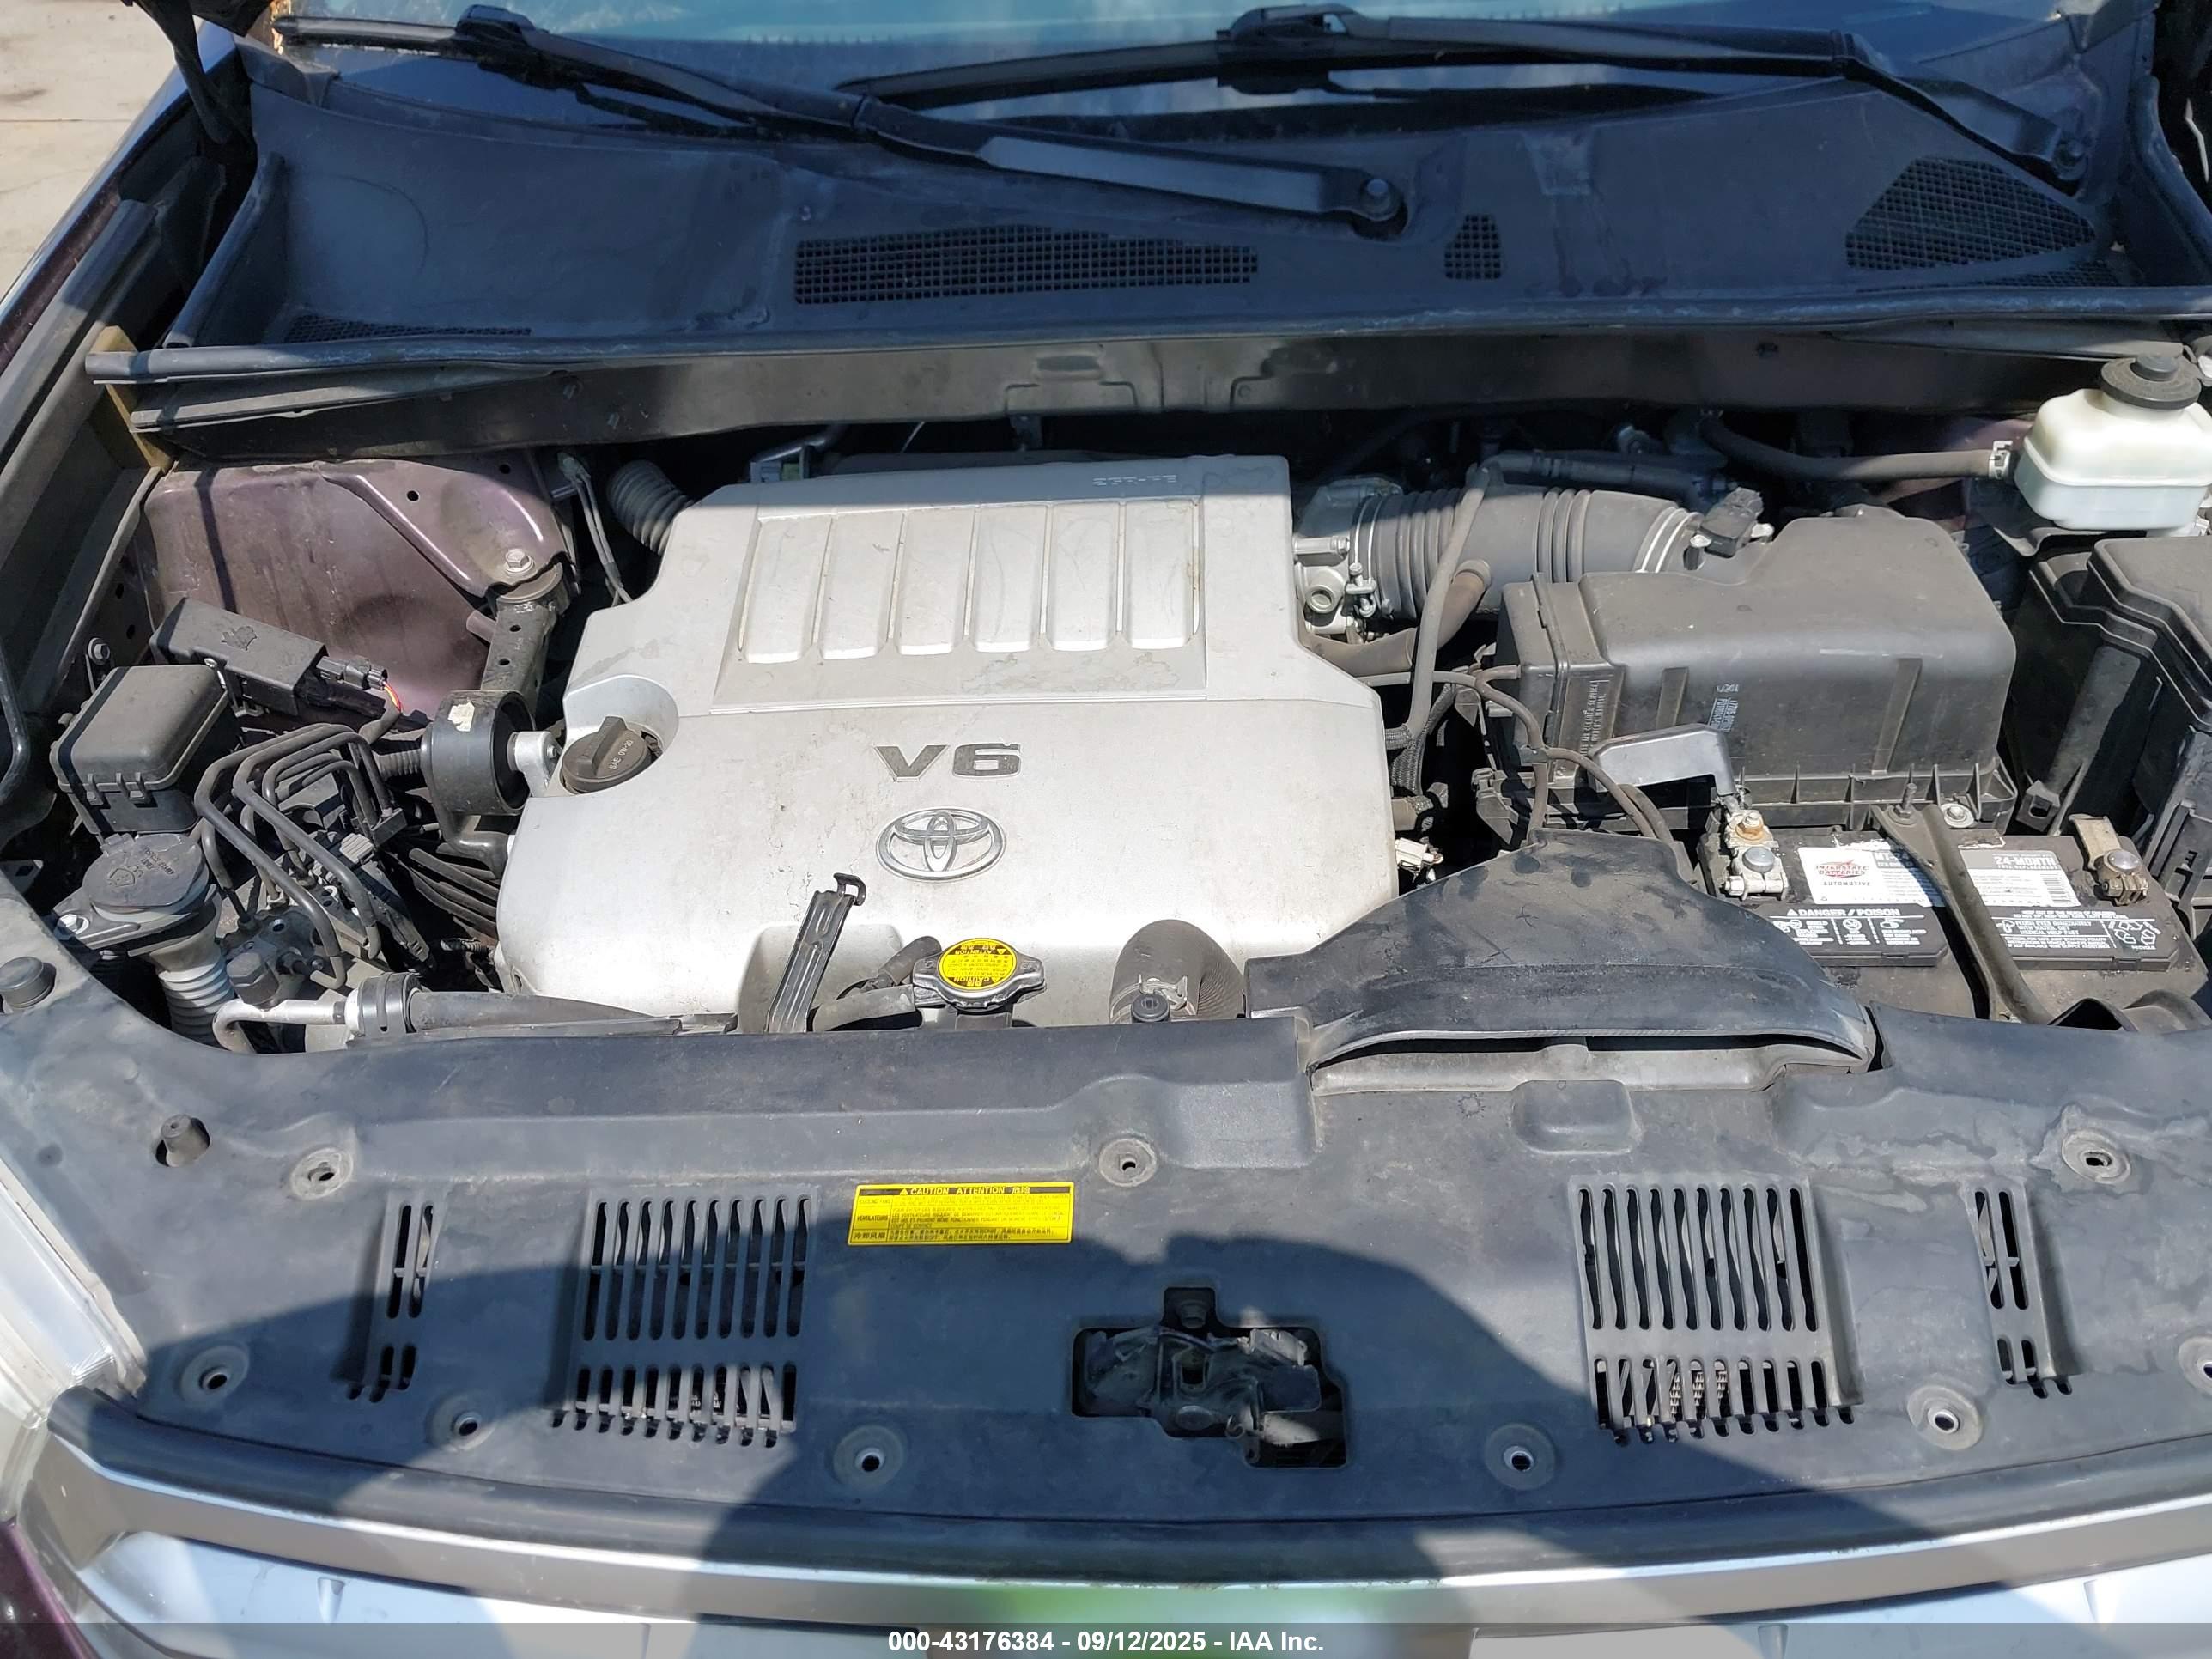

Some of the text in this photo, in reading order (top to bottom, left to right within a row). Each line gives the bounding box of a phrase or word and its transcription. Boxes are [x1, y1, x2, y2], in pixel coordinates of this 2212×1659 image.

[609, 757, 622, 769] SAE
[873, 743, 1022, 782] V6
[1994, 856, 2057, 866] 24-MONTH
